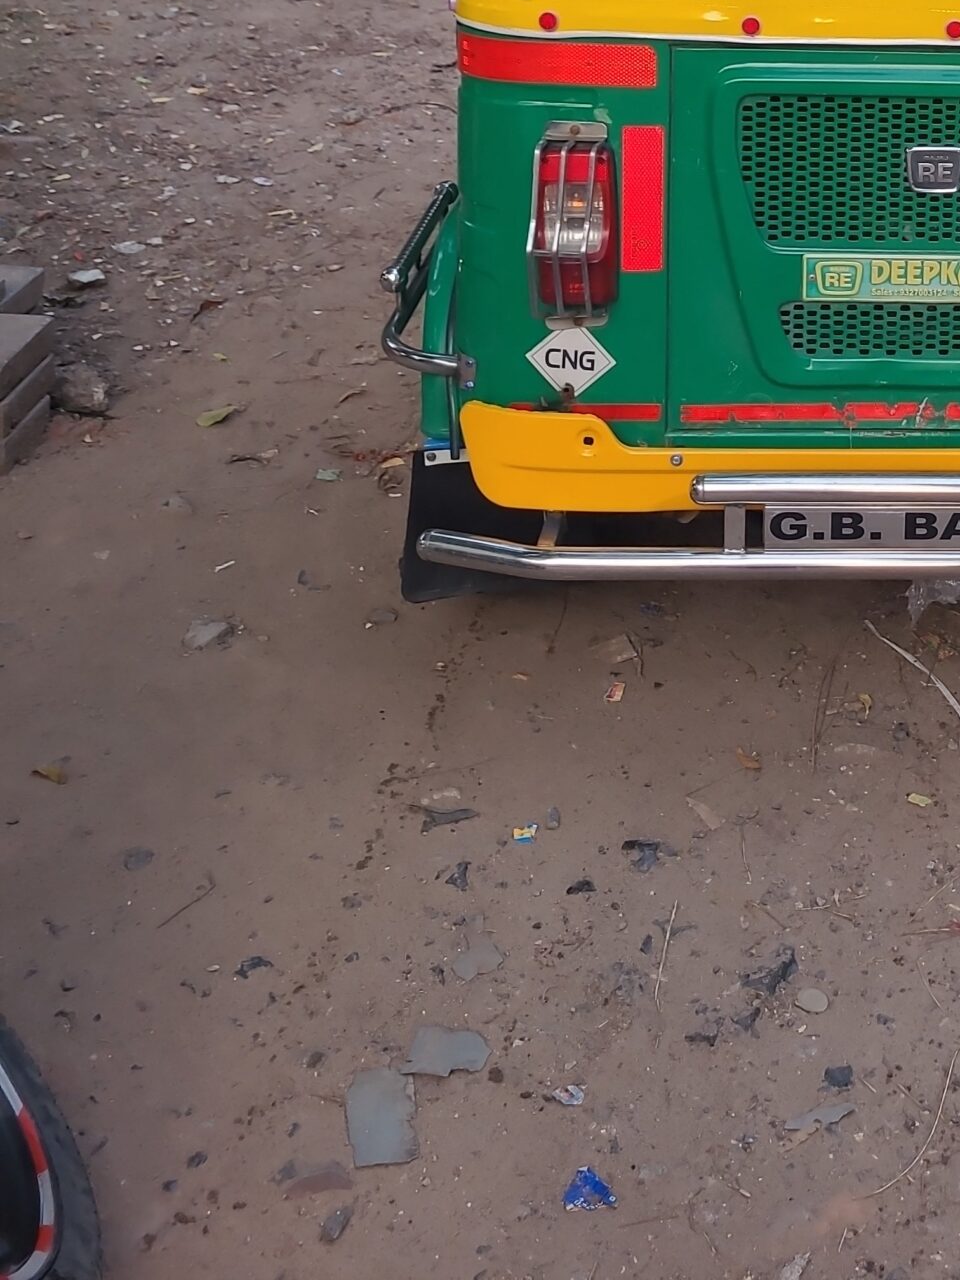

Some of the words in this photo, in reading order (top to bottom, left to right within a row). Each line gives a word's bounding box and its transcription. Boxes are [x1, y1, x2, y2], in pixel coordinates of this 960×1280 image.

[917, 162, 954, 183] RE
[825, 272, 853, 288] RE
[544, 347, 596, 372] CNG
[769, 511, 882, 541] G.B.
